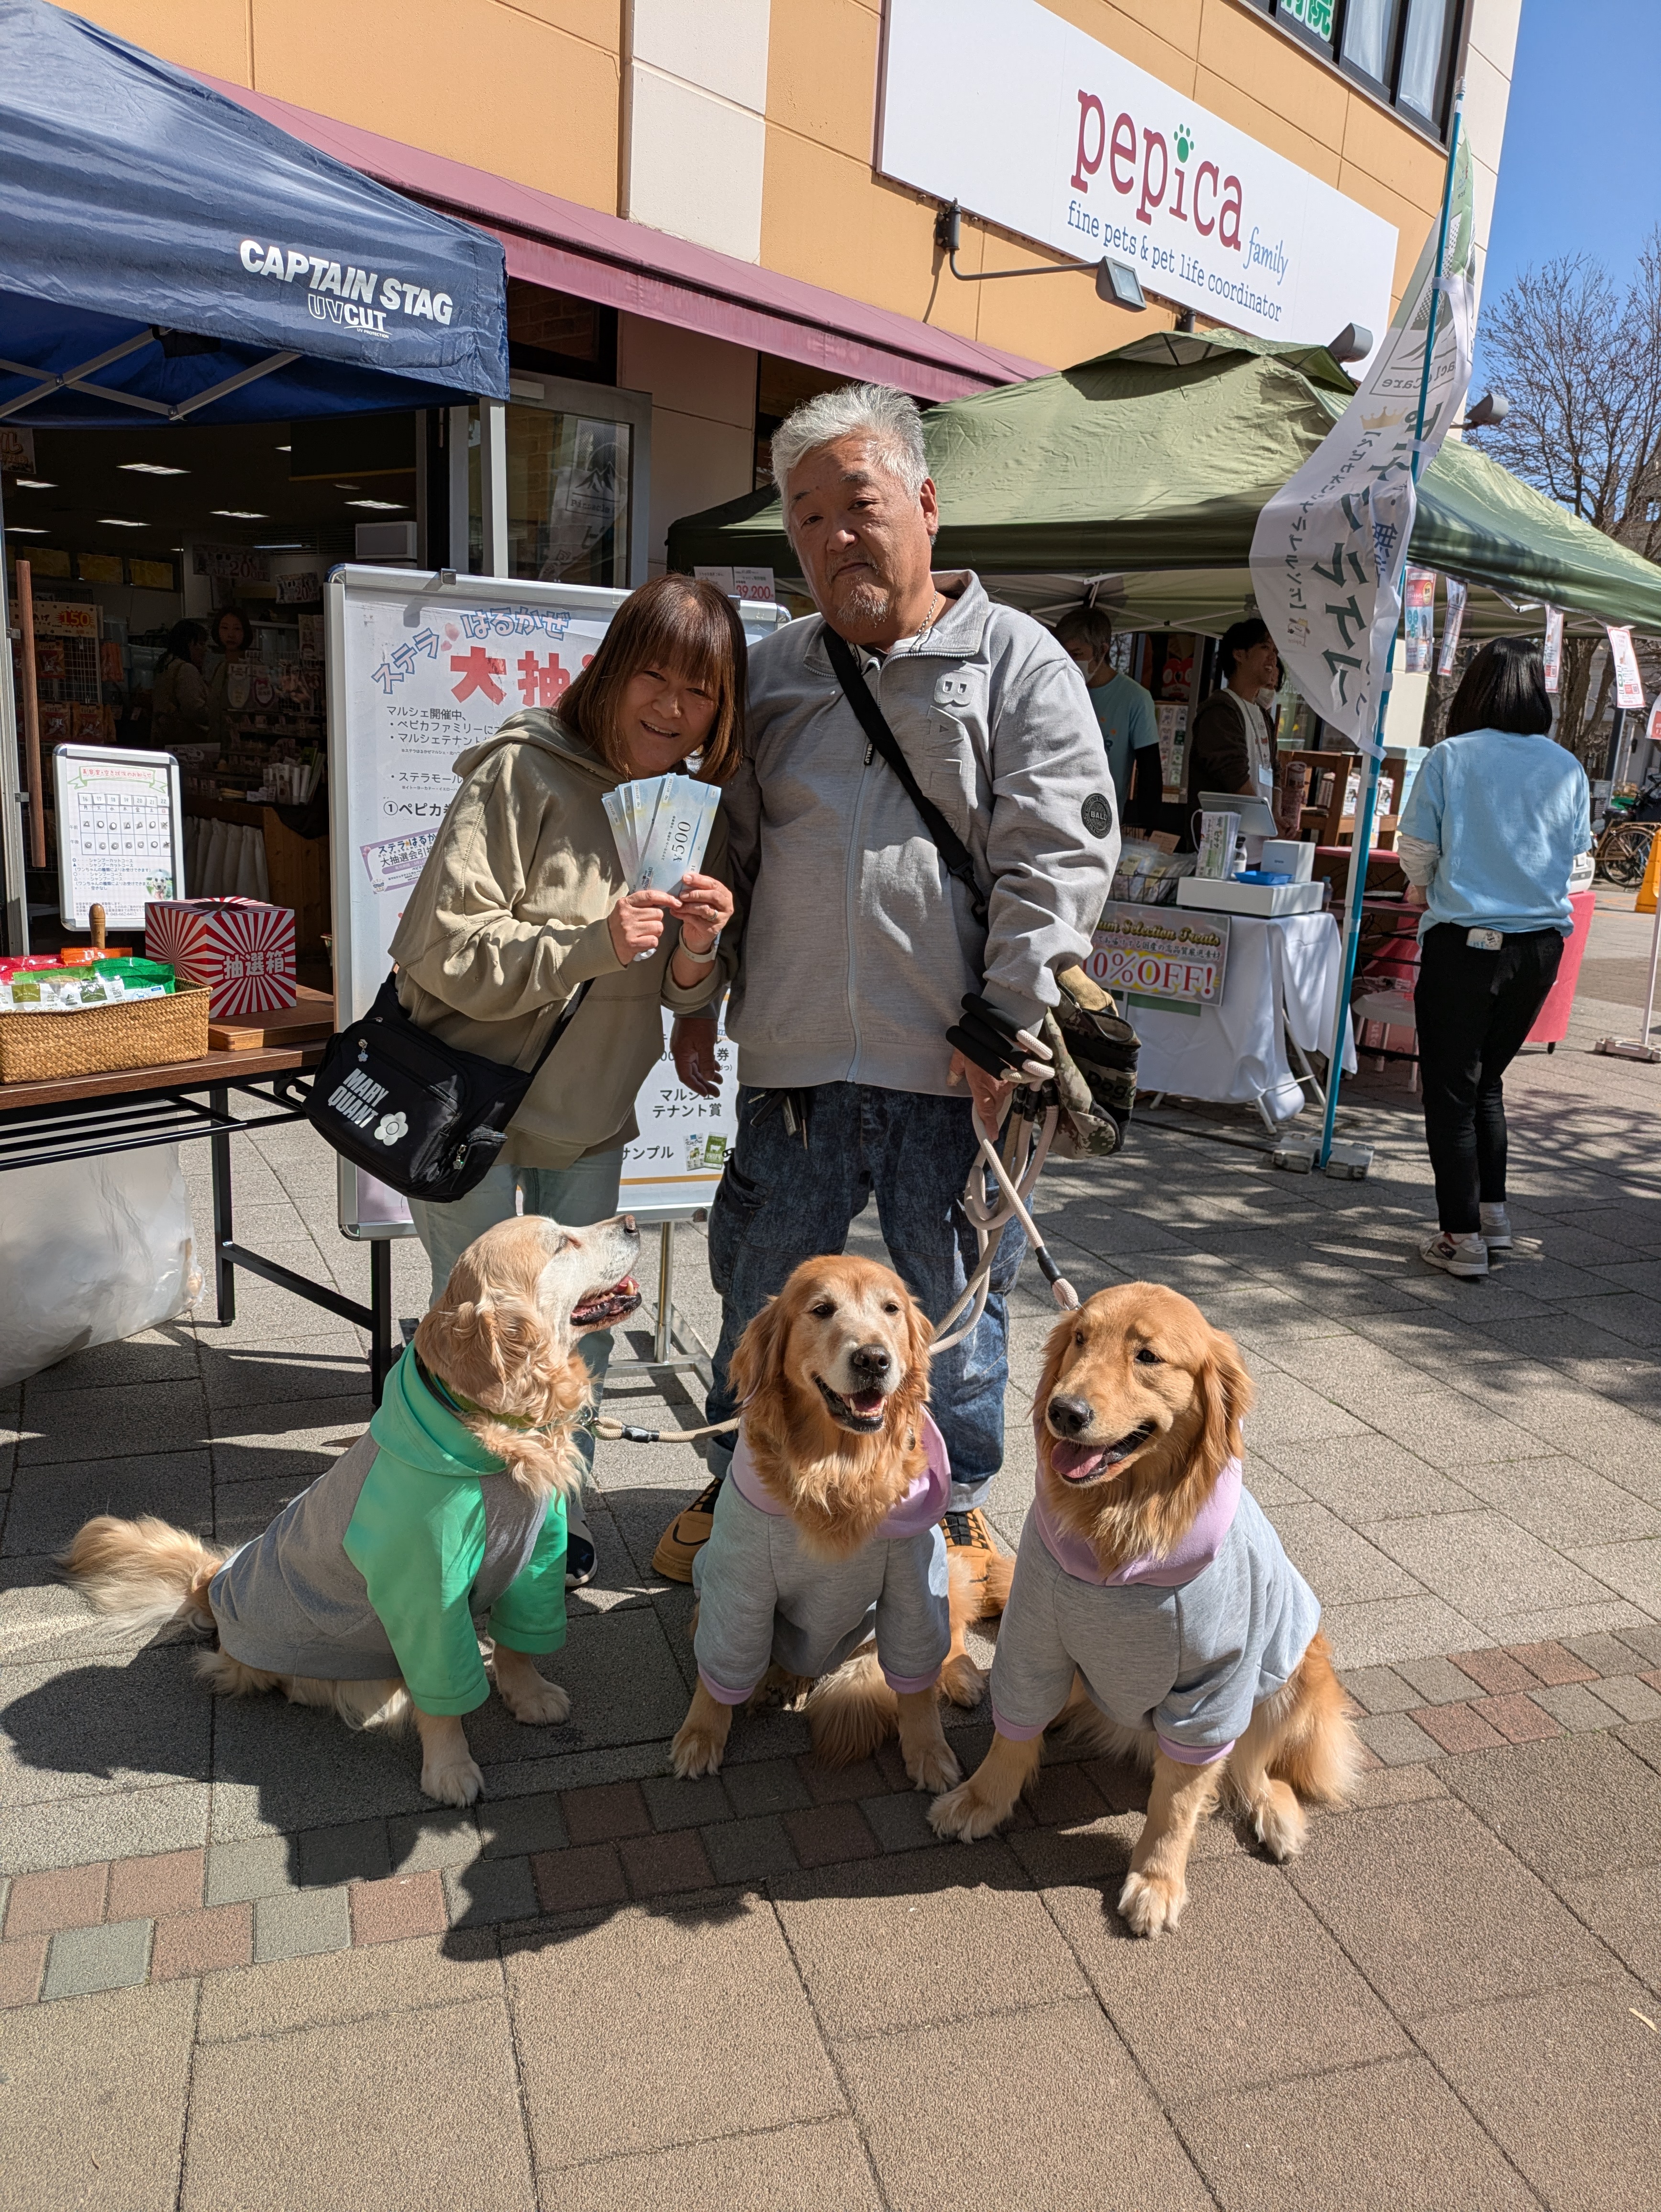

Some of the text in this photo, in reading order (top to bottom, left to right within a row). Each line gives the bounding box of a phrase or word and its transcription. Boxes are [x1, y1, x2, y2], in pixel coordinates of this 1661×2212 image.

[1280, 0, 1334, 42] 院
[1071, 89, 1289, 286] pepica family
[1067, 199, 1282, 322] fine pets & pet life coordinator
[240, 240, 453, 325] CAPTAIN STAG
[364, 330, 388, 339] PROTECTION
[371, 606, 571, 694] ステラ はるかぜ
[450, 646, 595, 707] 大抽
[386, 706, 466, 721] マルシェ開催中、
[390, 720, 499, 735] ・ペピカファミリーに
[390, 732, 489, 746] ・マルシェテナント
[378, 841, 405, 854] ステラ
[672, 821, 691, 862] ¥500
[1122, 919, 1176, 941] Selection
[1178, 927, 1221, 947] Treats
[223, 950, 286, 979] 抽選箱
[343, 1068, 389, 1105] MARY
[328, 1086, 378, 1128] QUANT
[653, 1103, 721, 1117] テナント賞
